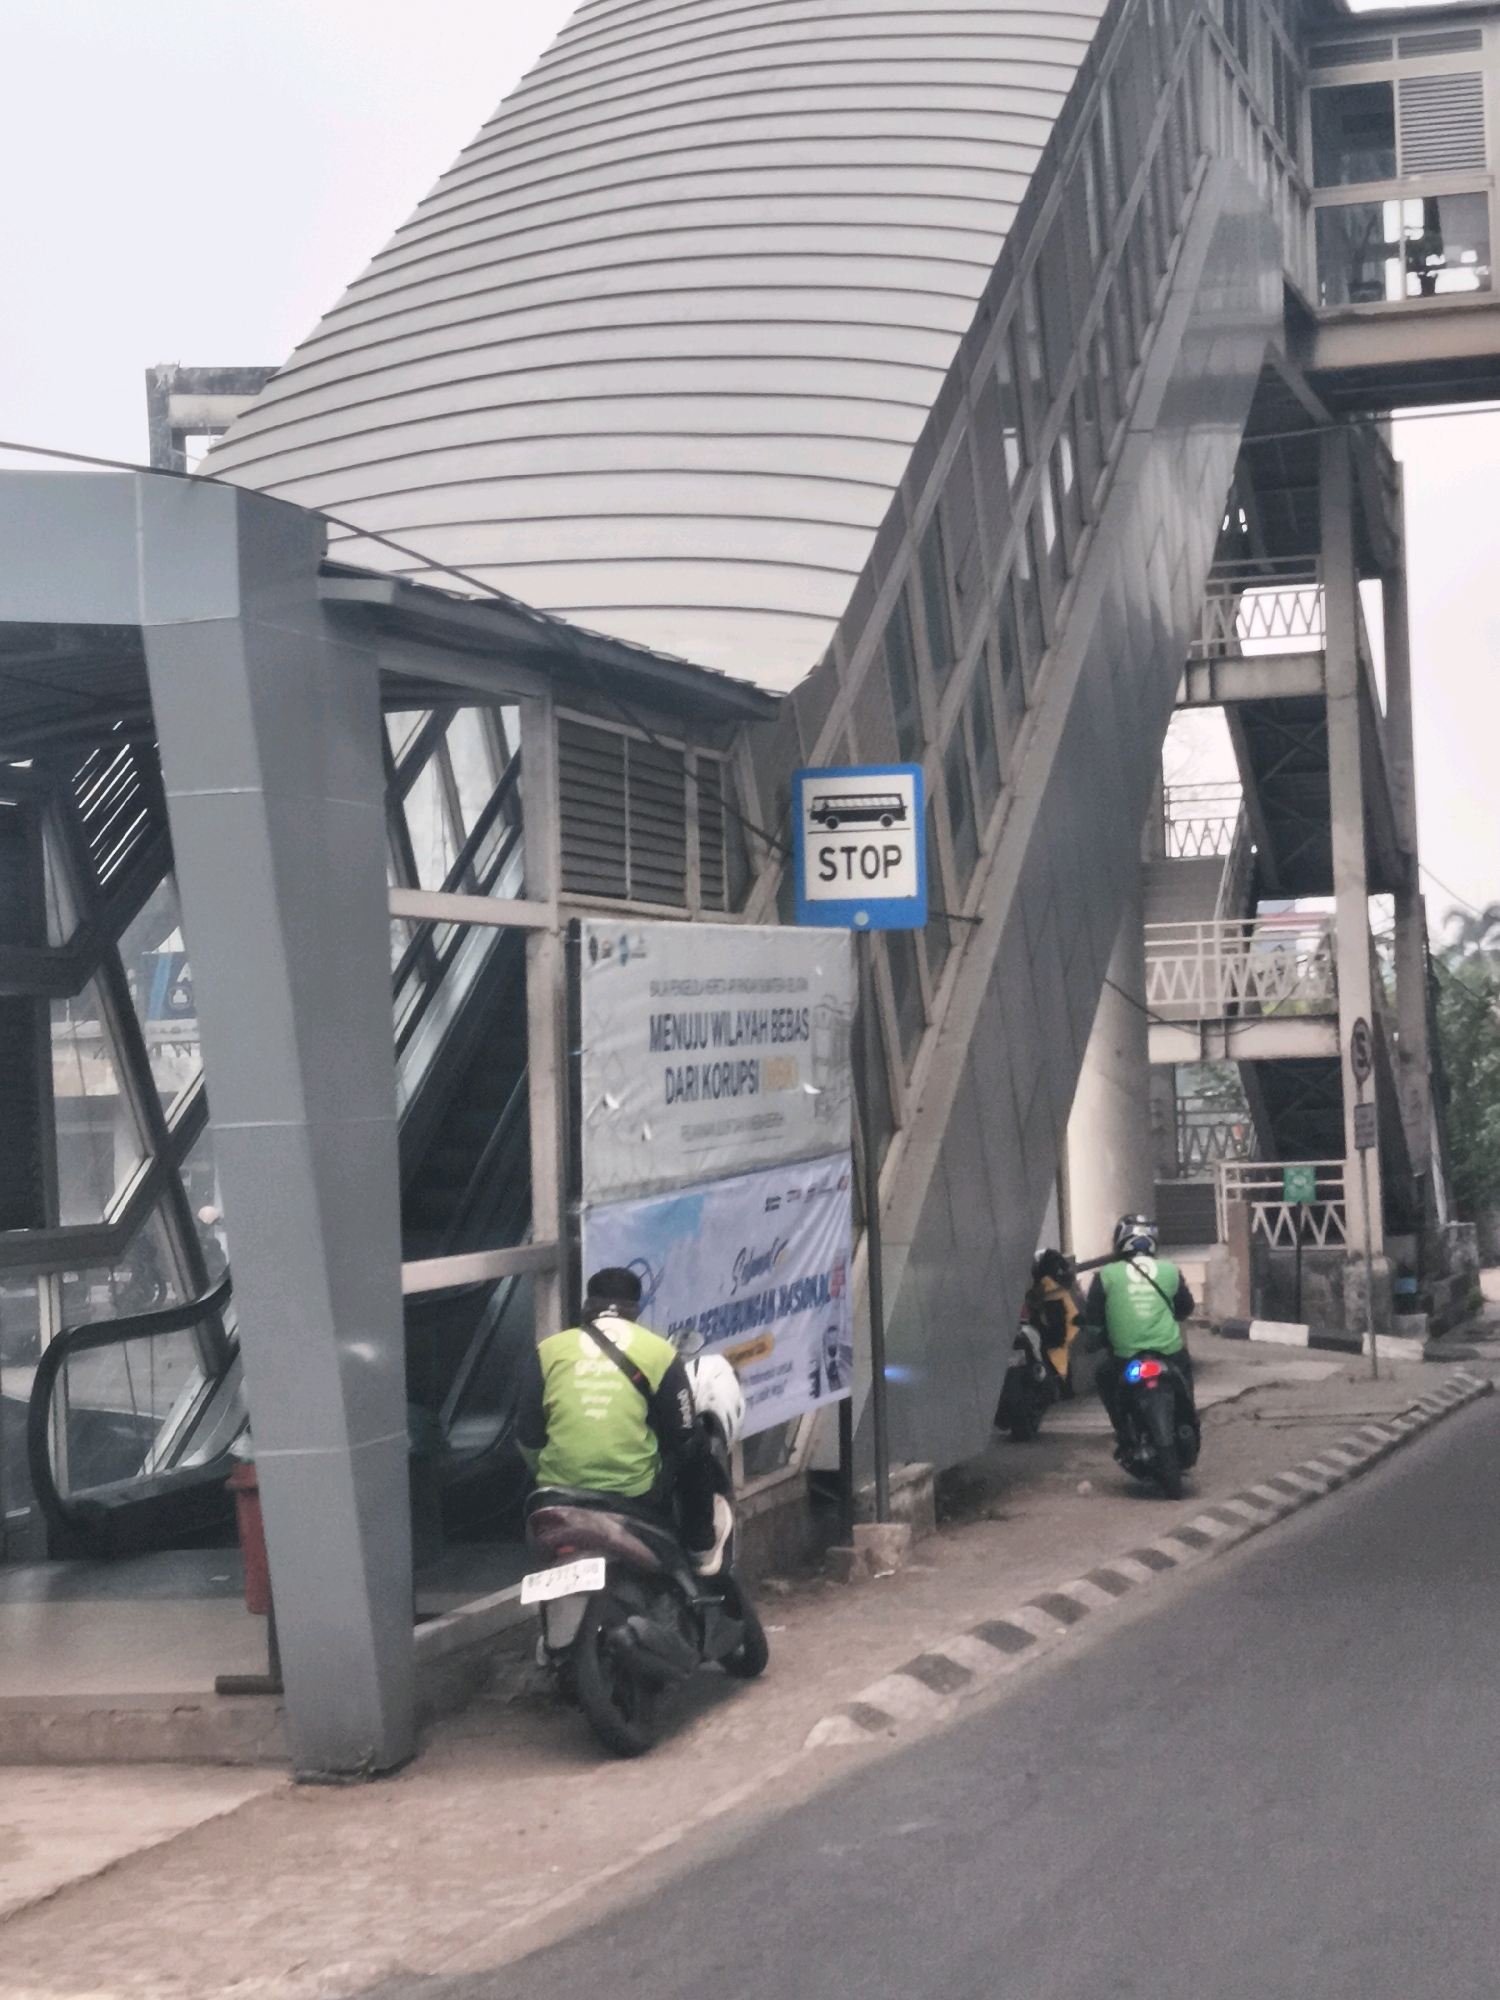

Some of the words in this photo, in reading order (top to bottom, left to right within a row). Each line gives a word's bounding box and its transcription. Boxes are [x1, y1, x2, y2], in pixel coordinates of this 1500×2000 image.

[818, 844, 902, 881] STOP
[649, 1012, 708, 1052] MENUJU
[711, 1009, 769, 1048] WILAYAH
[771, 1008, 810, 1046] BEBAS
[665, 1063, 699, 1105] DARI
[702, 1059, 760, 1101] KORUPSI
